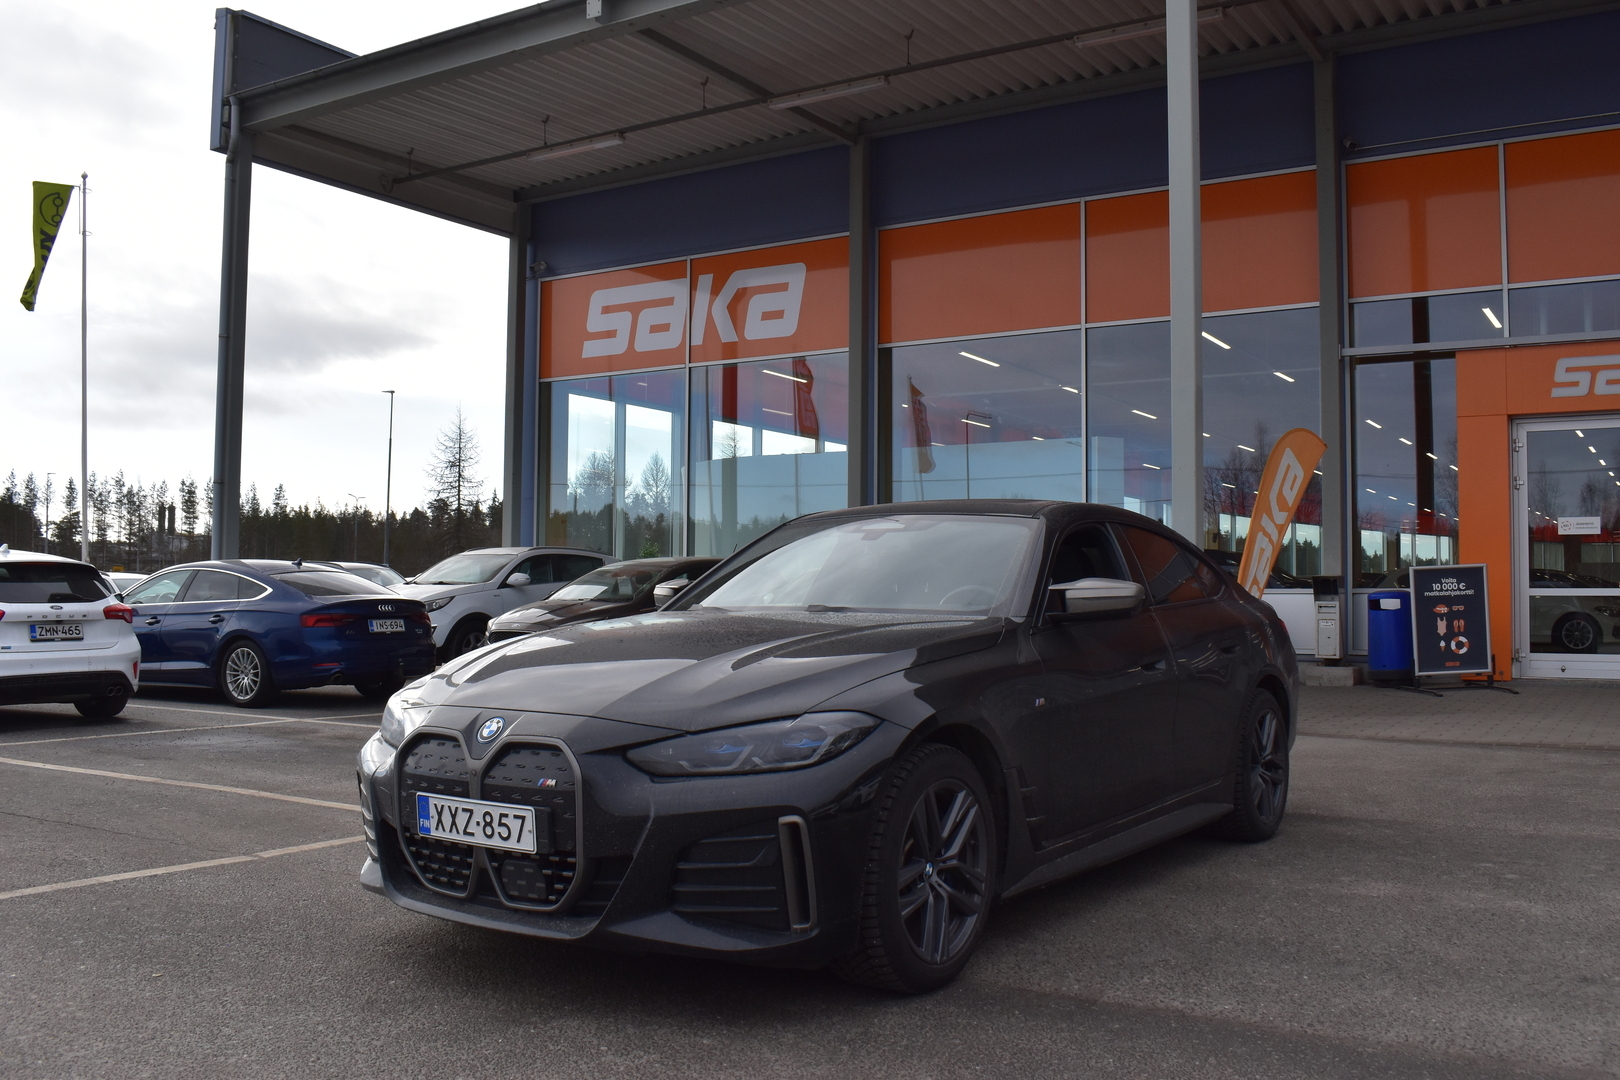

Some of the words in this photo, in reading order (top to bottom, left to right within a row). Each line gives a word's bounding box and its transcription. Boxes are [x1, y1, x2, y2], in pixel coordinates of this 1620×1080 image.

[1424, 589, 1474, 597] matkalahjakortti!
[375, 620, 403, 630] INS-694
[38, 626, 81, 637] ZMN-465
[420, 818, 431, 829] FIN
[433, 803, 527, 844] XXZ-857
